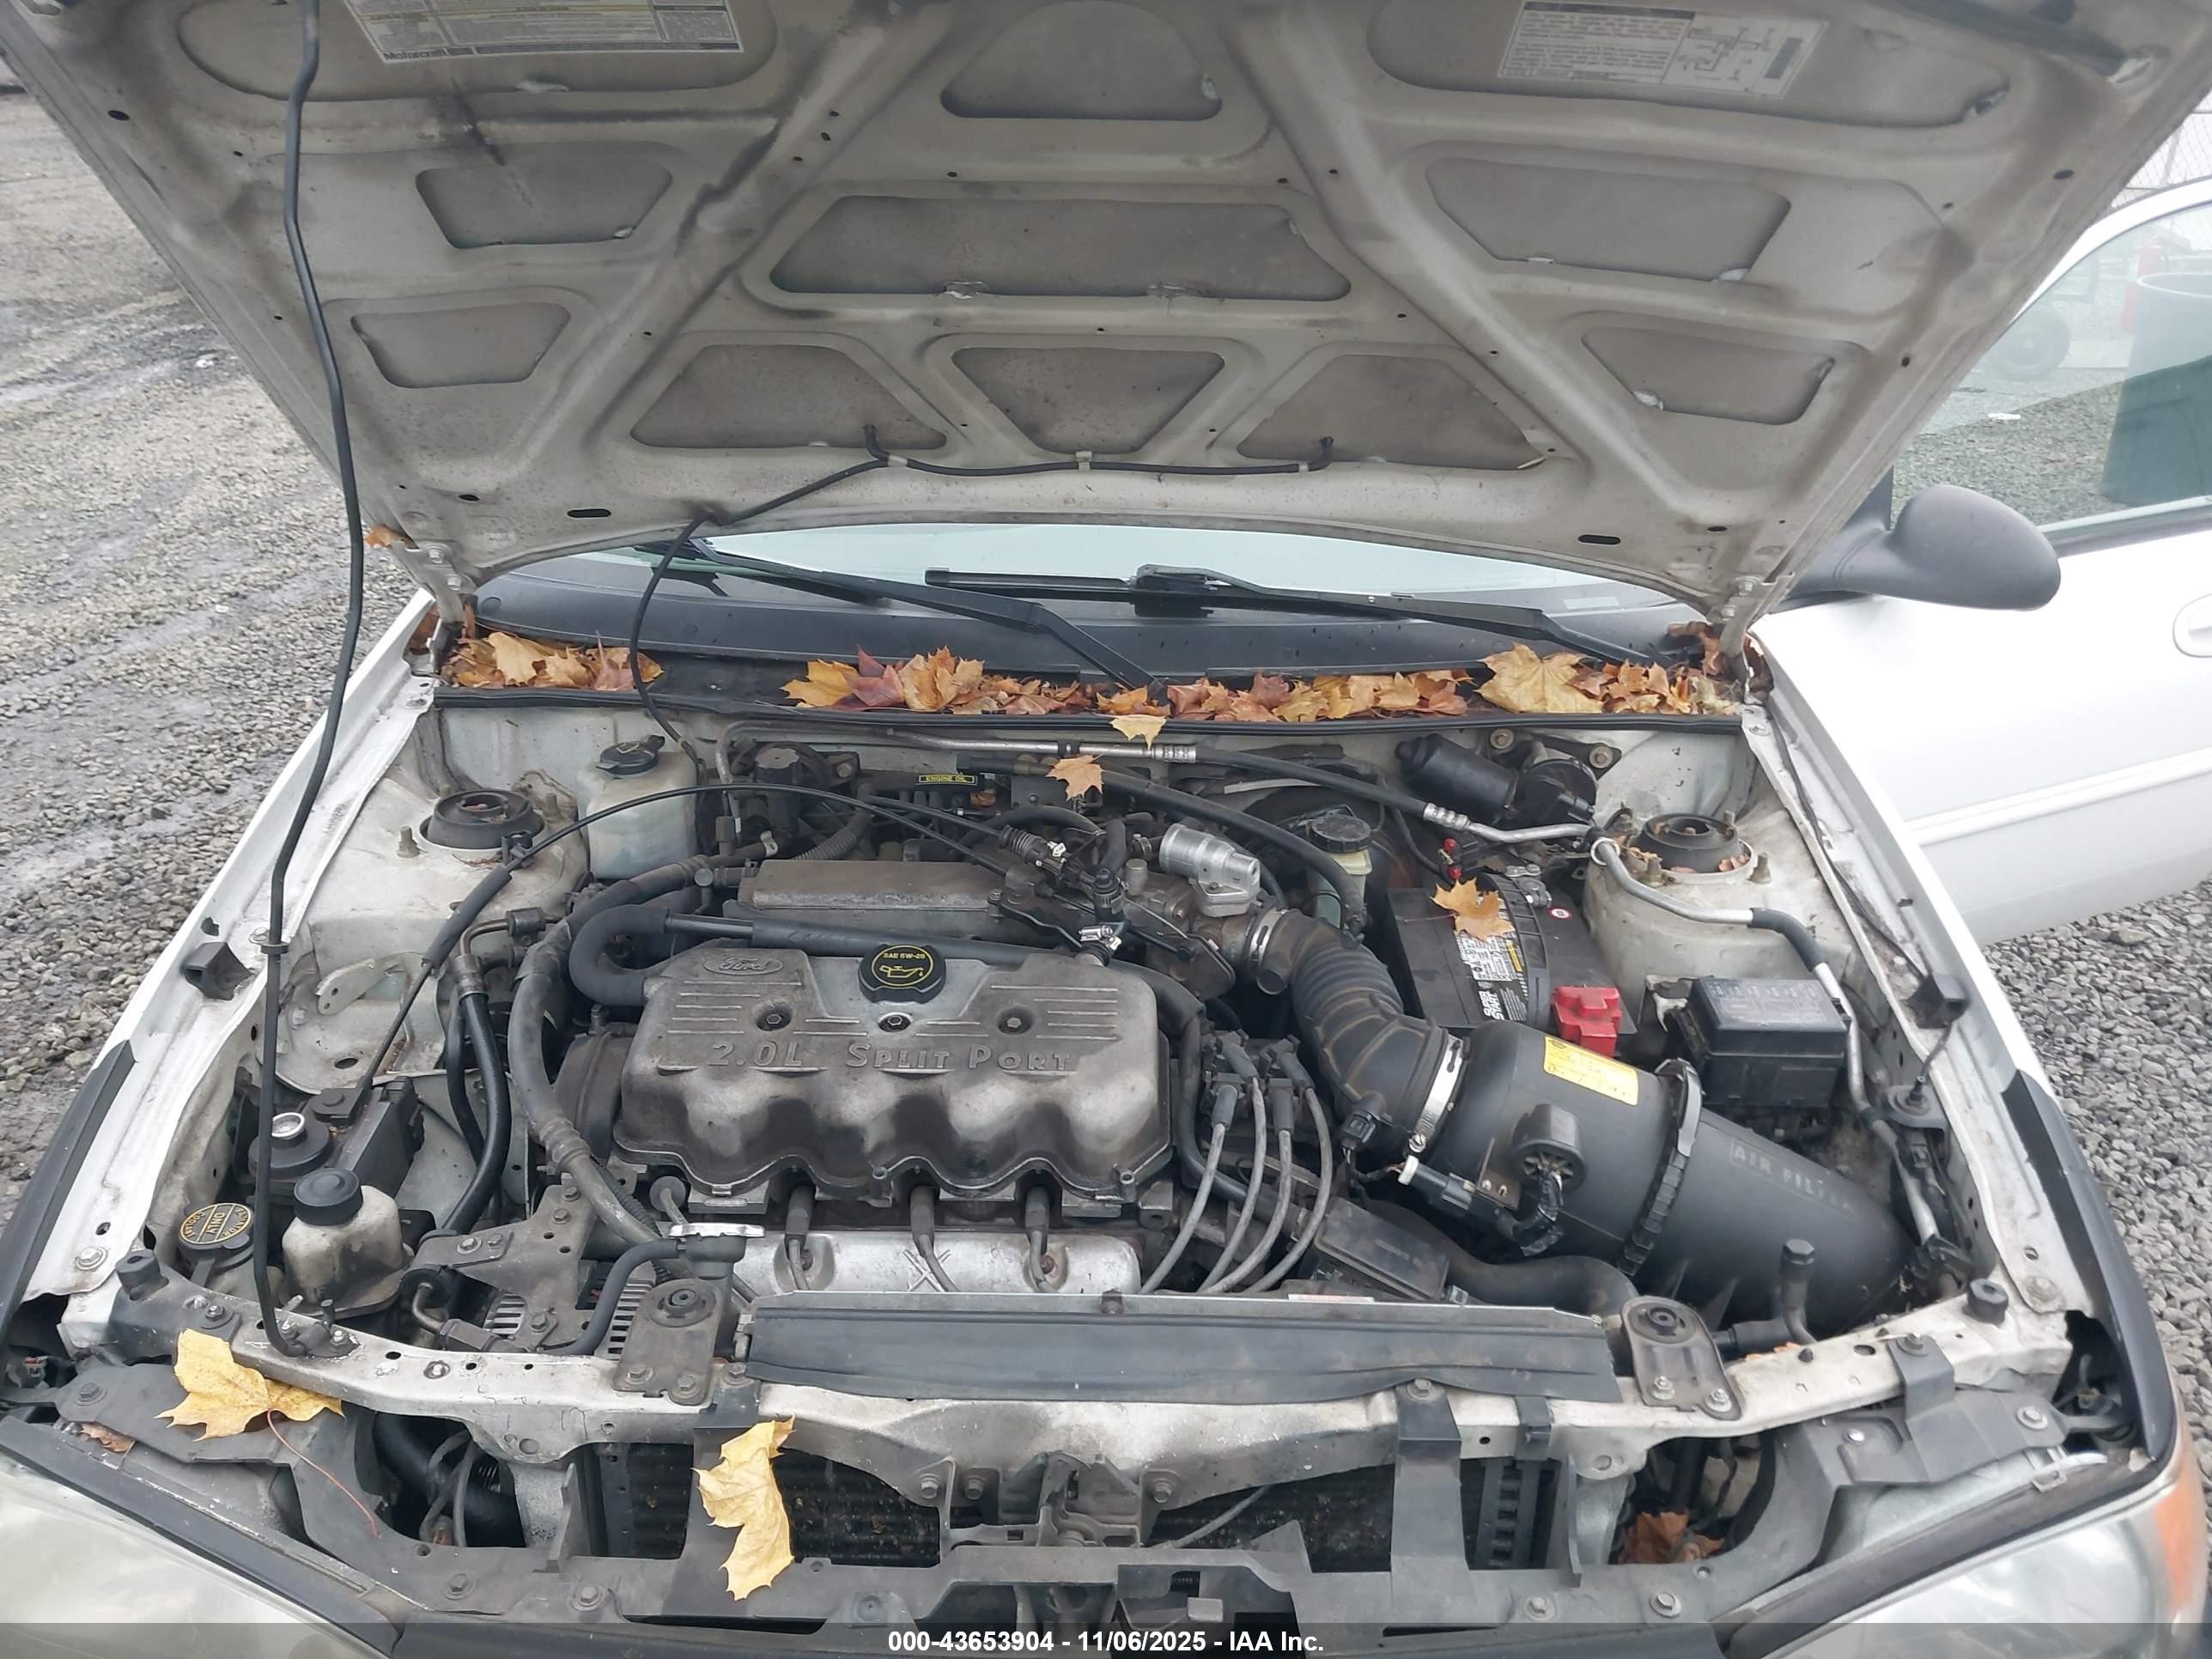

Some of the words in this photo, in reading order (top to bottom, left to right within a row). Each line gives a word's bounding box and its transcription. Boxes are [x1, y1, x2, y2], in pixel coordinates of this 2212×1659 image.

[719, 957, 769, 973] Ford
[1478, 990, 1492, 1017] SUPER
[709, 1043, 802, 1066] 2.0L
[1734, 1144, 1773, 1176] AIR
[1783, 1168, 1855, 1213] FILT
[184, 1212, 206, 1237] COOLANT
[206, 1212, 226, 1235] ONLY
